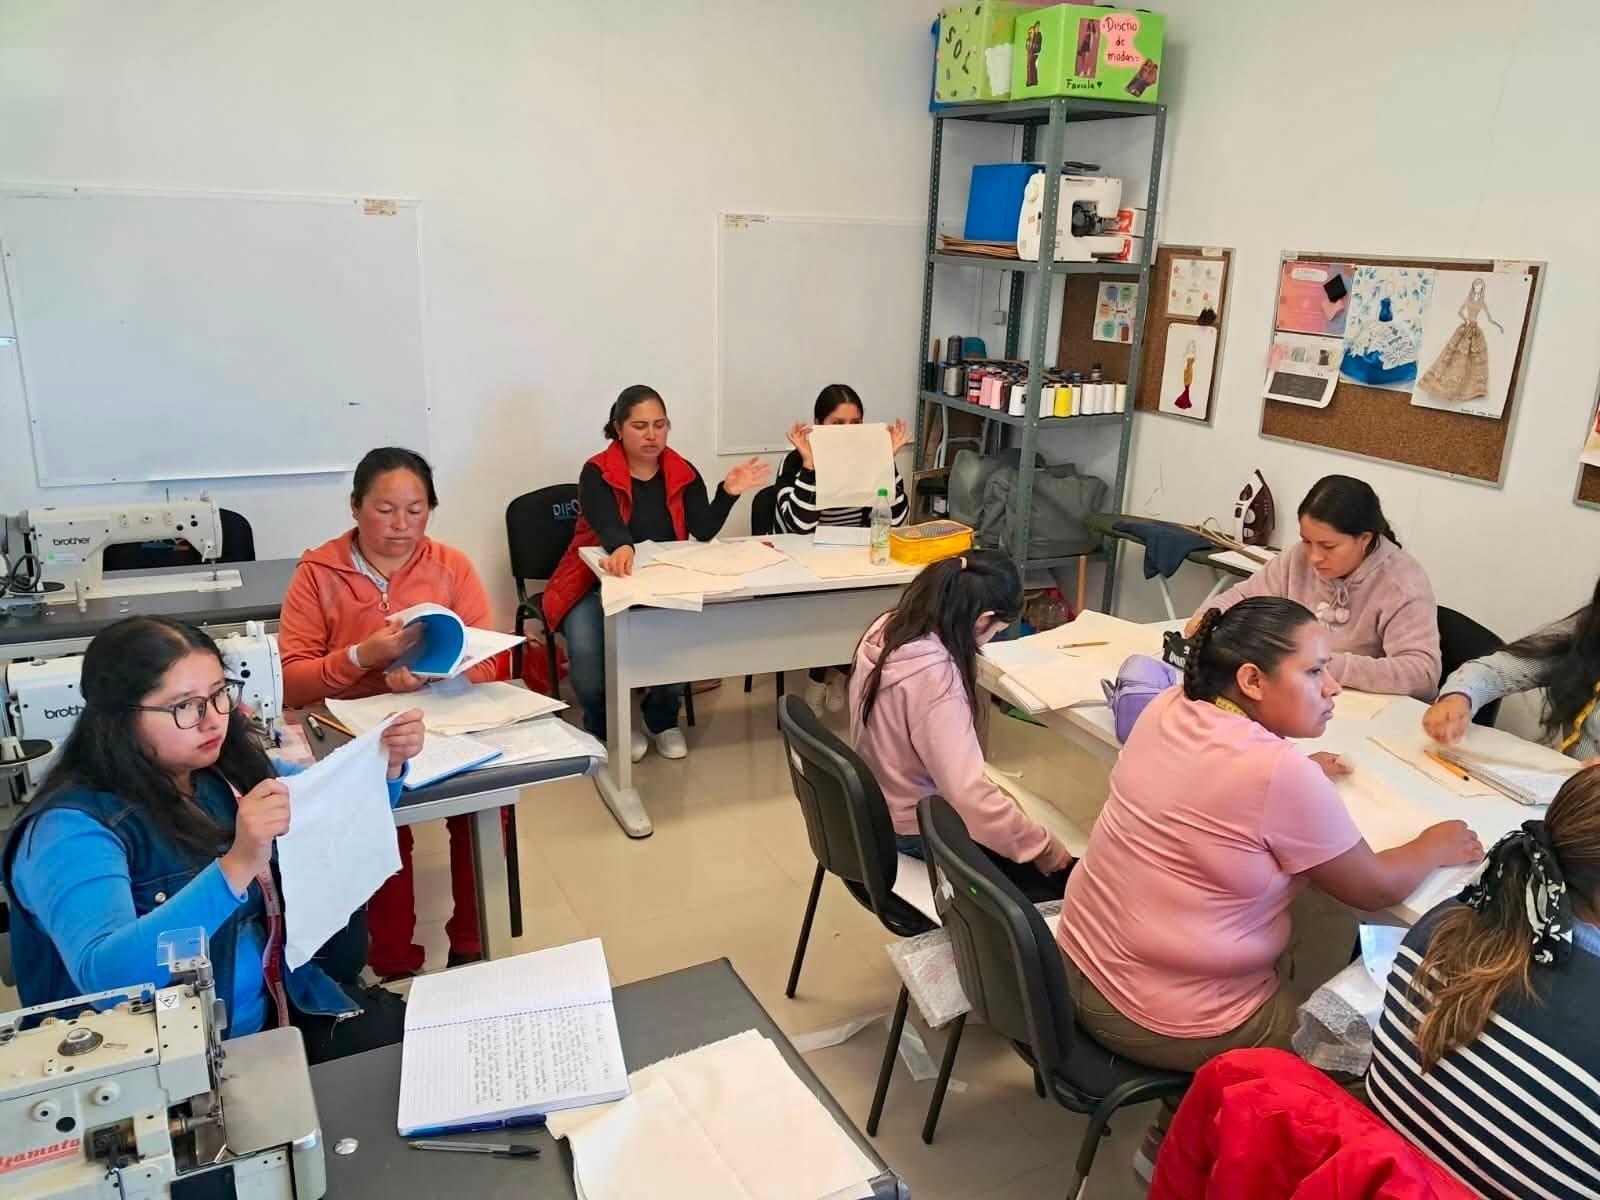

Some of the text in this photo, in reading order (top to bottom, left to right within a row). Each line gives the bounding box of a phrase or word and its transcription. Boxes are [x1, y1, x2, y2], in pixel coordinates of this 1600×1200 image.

[1115, 35, 1125, 47] de
[52, 536, 90, 546] brother
[43, 704, 86, 719] broth
